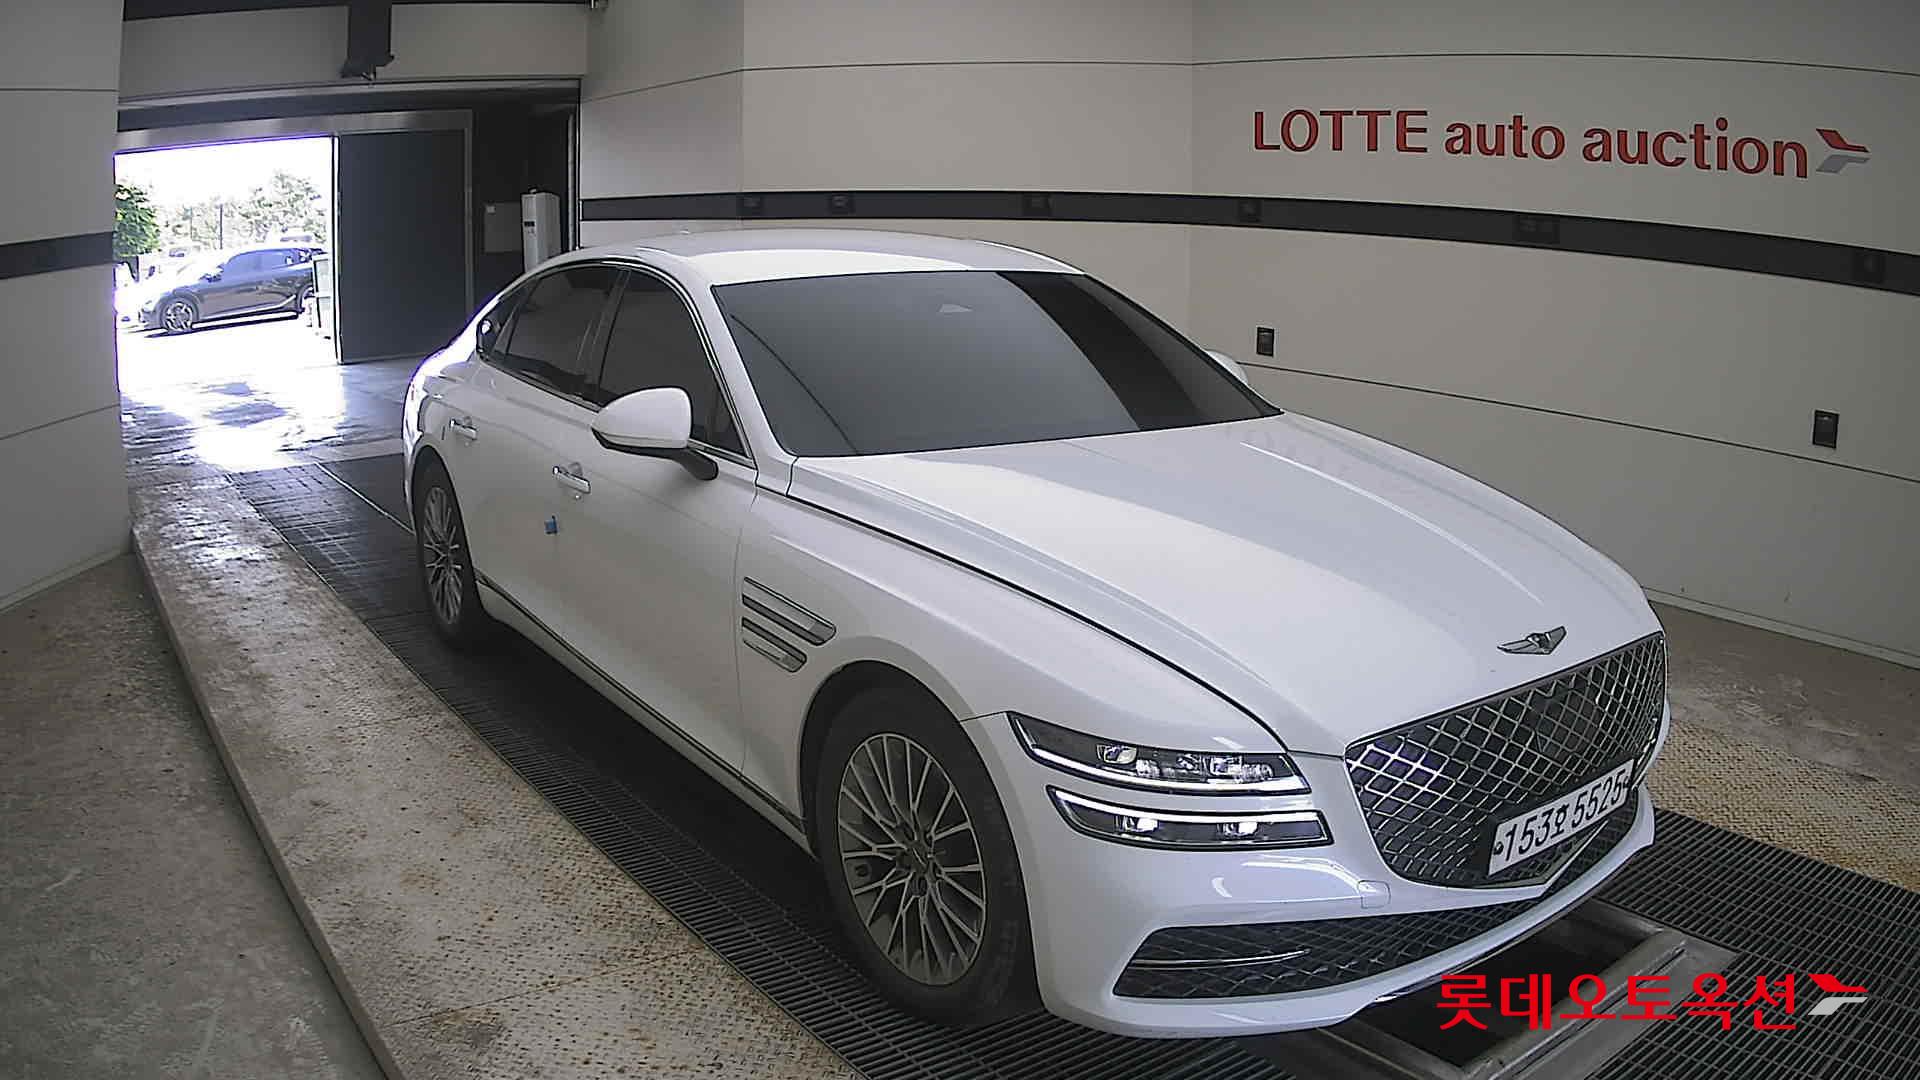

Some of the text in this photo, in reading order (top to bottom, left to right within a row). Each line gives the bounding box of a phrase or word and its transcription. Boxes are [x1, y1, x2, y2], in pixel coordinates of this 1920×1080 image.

[1253, 109, 1809, 179] LOTTE auto auction
[1571, 768, 1626, 829] 5525
